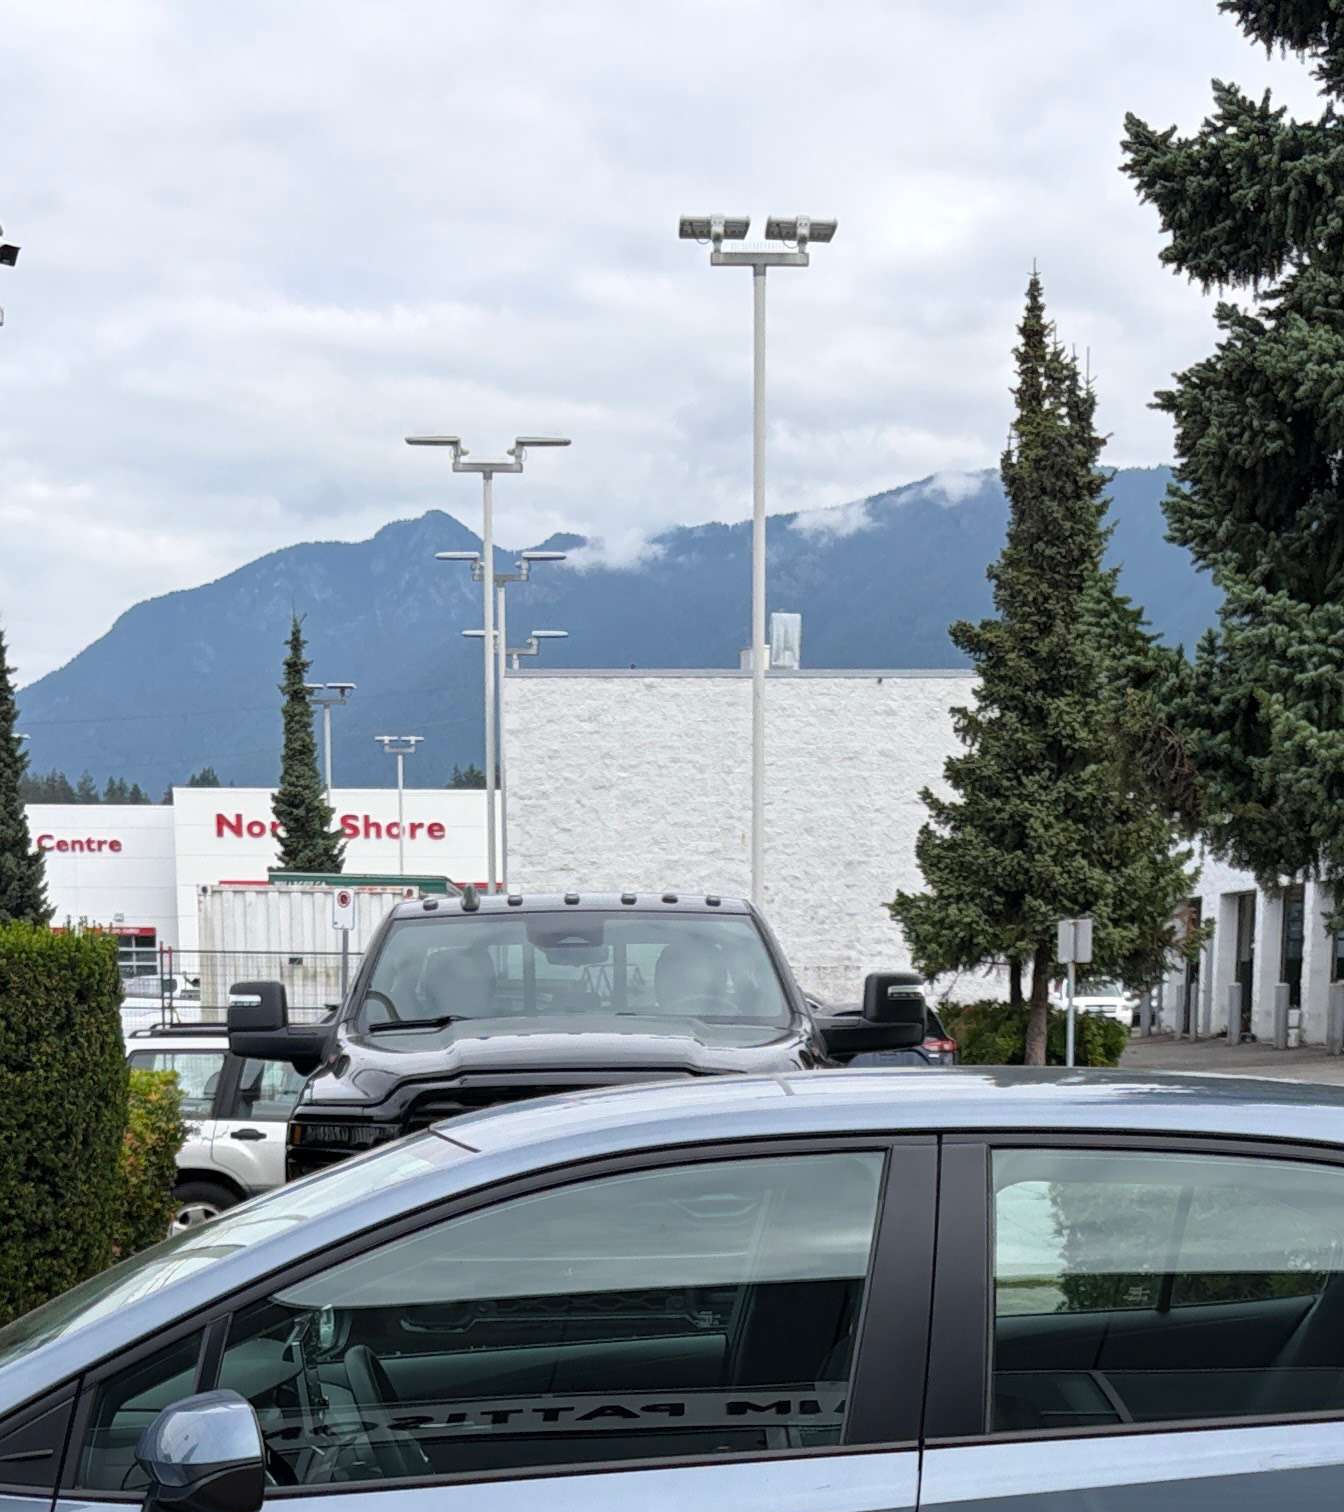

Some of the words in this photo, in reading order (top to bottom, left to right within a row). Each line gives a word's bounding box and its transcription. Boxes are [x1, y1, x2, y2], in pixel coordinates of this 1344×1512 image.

[215, 814, 288, 838] Nor
[340, 814, 446, 840] Shore
[37, 834, 122, 852] Centre
